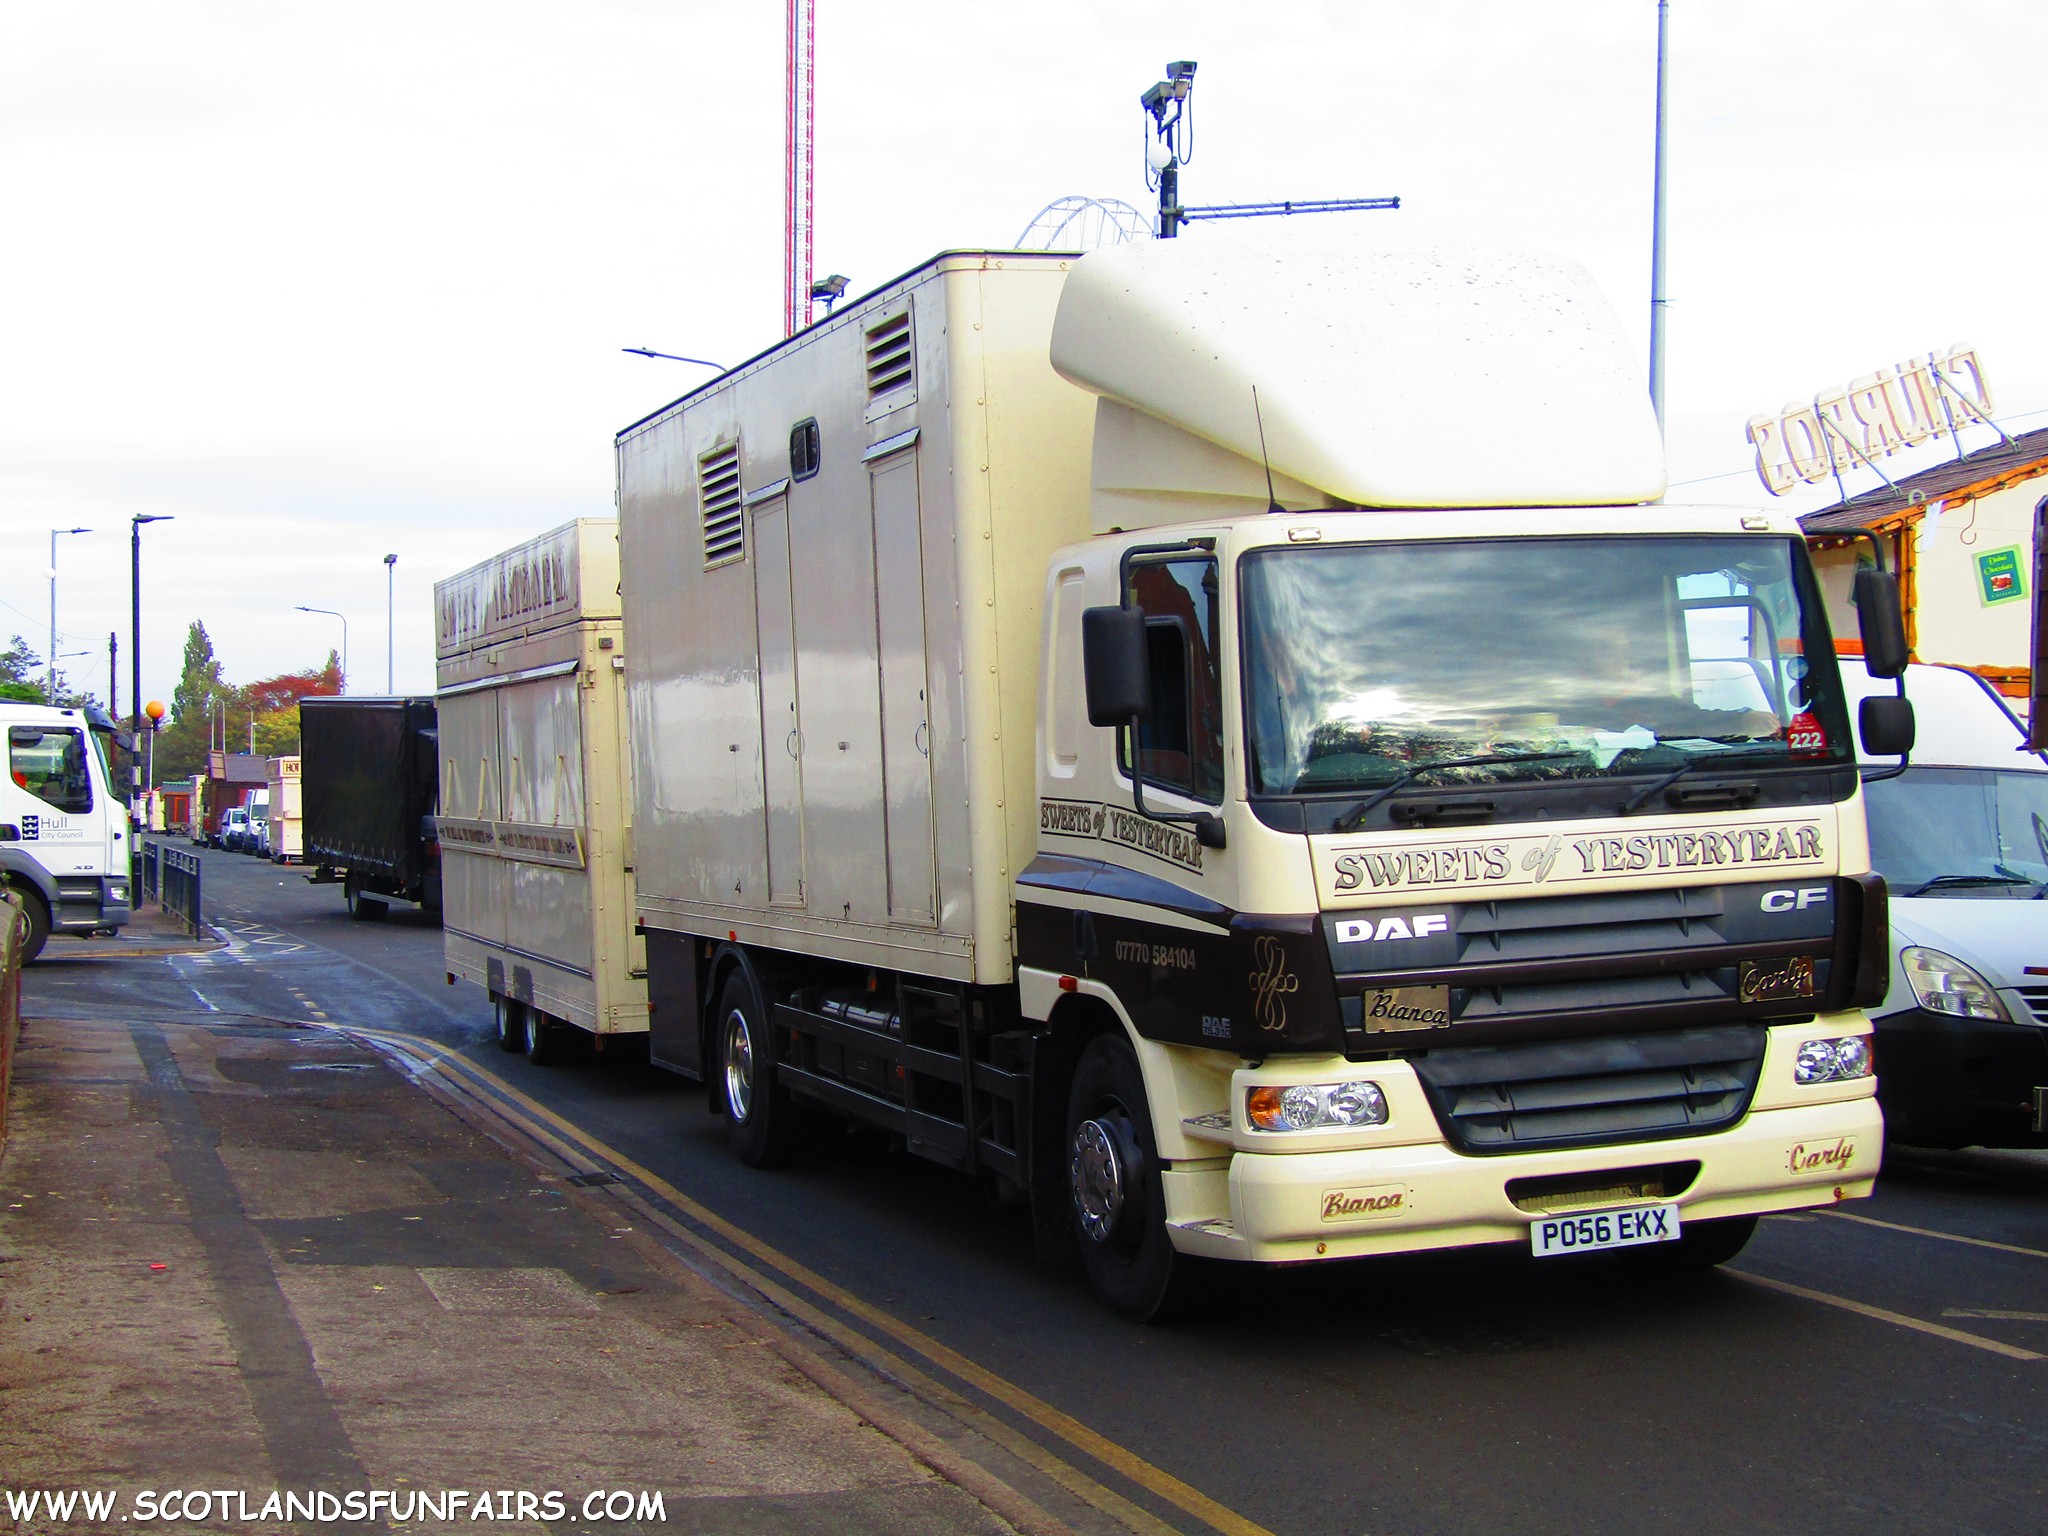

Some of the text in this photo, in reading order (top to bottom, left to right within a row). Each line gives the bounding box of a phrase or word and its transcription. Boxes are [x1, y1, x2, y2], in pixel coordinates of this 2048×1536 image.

[1790, 732, 1823, 749] 222
[285, 762, 300, 773] HOT
[41, 817, 68, 829] Hull
[41, 832, 56, 840] City
[1041, 802, 1203, 869] SWEETS of YESTERYEAR
[1334, 825, 1824, 890] SWEETS of YESTERYEAR
[1760, 887, 1828, 913] CF
[1335, 914, 1448, 944] DAF
[1115, 940, 1196, 970] 07770 584104
[1743, 957, 1811, 997] Carly
[1368, 992, 1448, 1024] Bianca
[1790, 1136, 1855, 1171] Carly
[1323, 1192, 1404, 1218] Bianca
[1617, 1208, 1668, 1240] EKX
